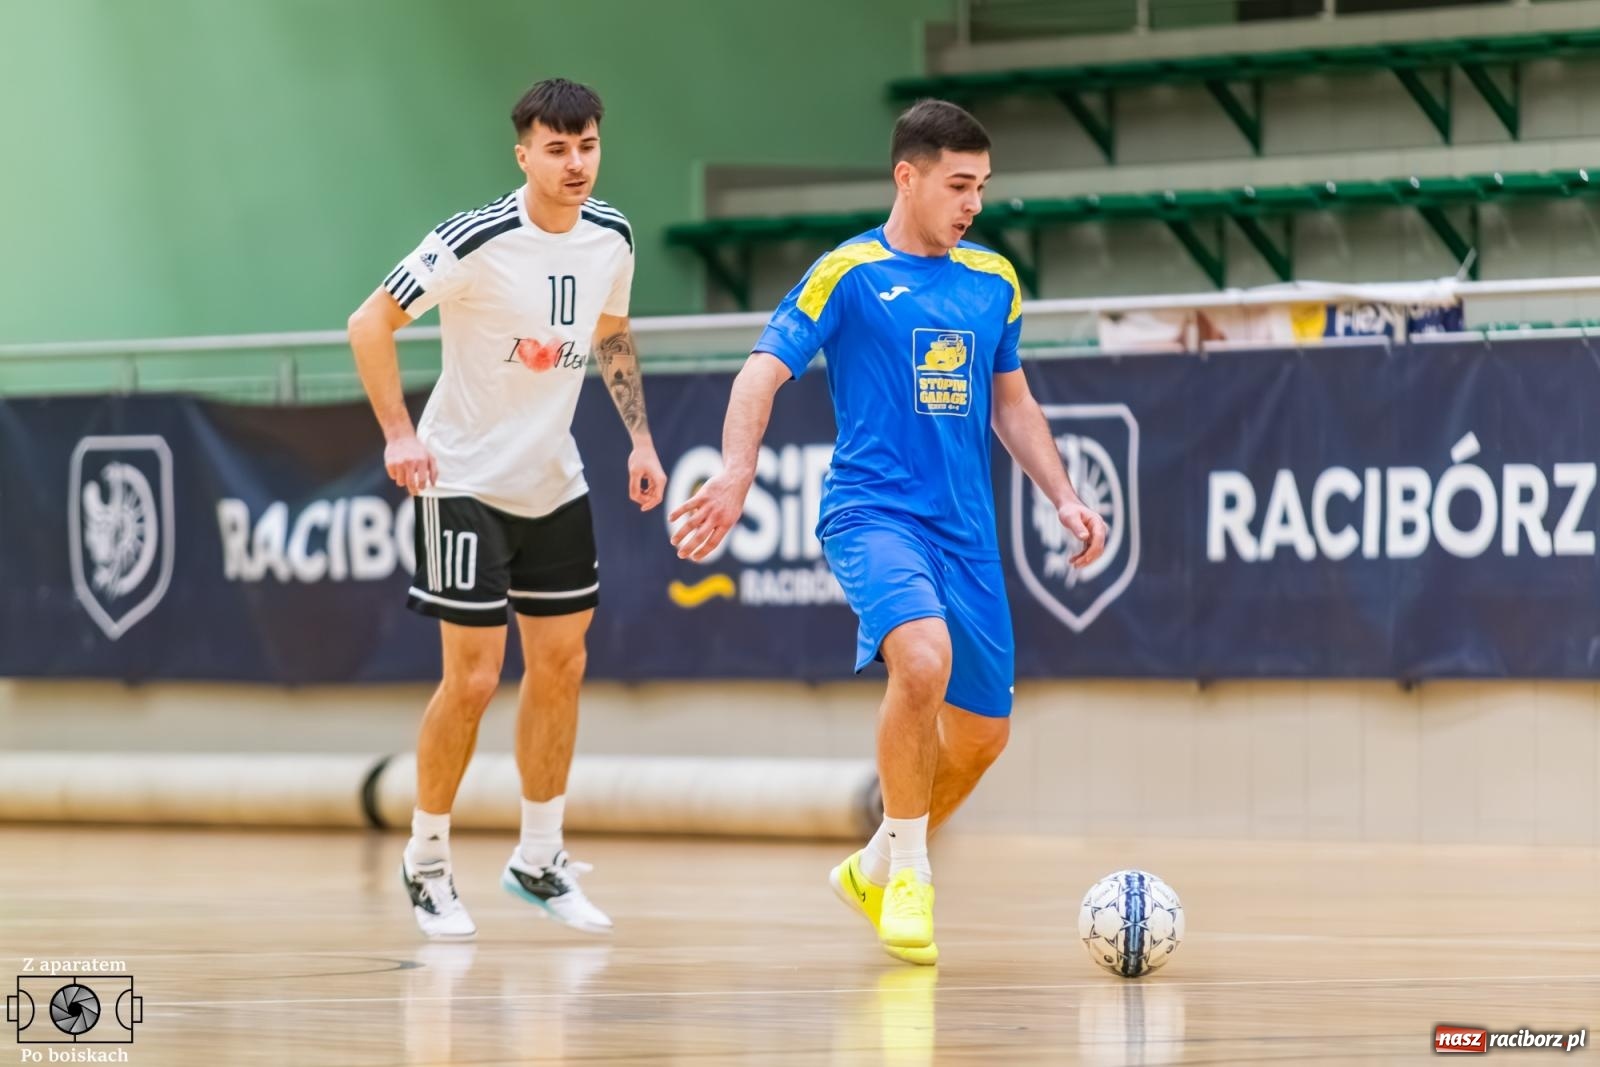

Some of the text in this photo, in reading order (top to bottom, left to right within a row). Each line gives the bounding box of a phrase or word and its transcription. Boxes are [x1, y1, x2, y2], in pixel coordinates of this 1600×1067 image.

[548, 275, 575, 326] 10
[920, 391, 967, 405] GARAGE
[1206, 431, 1597, 562] RACIBÓRZ
[443, 529, 478, 590] 10
